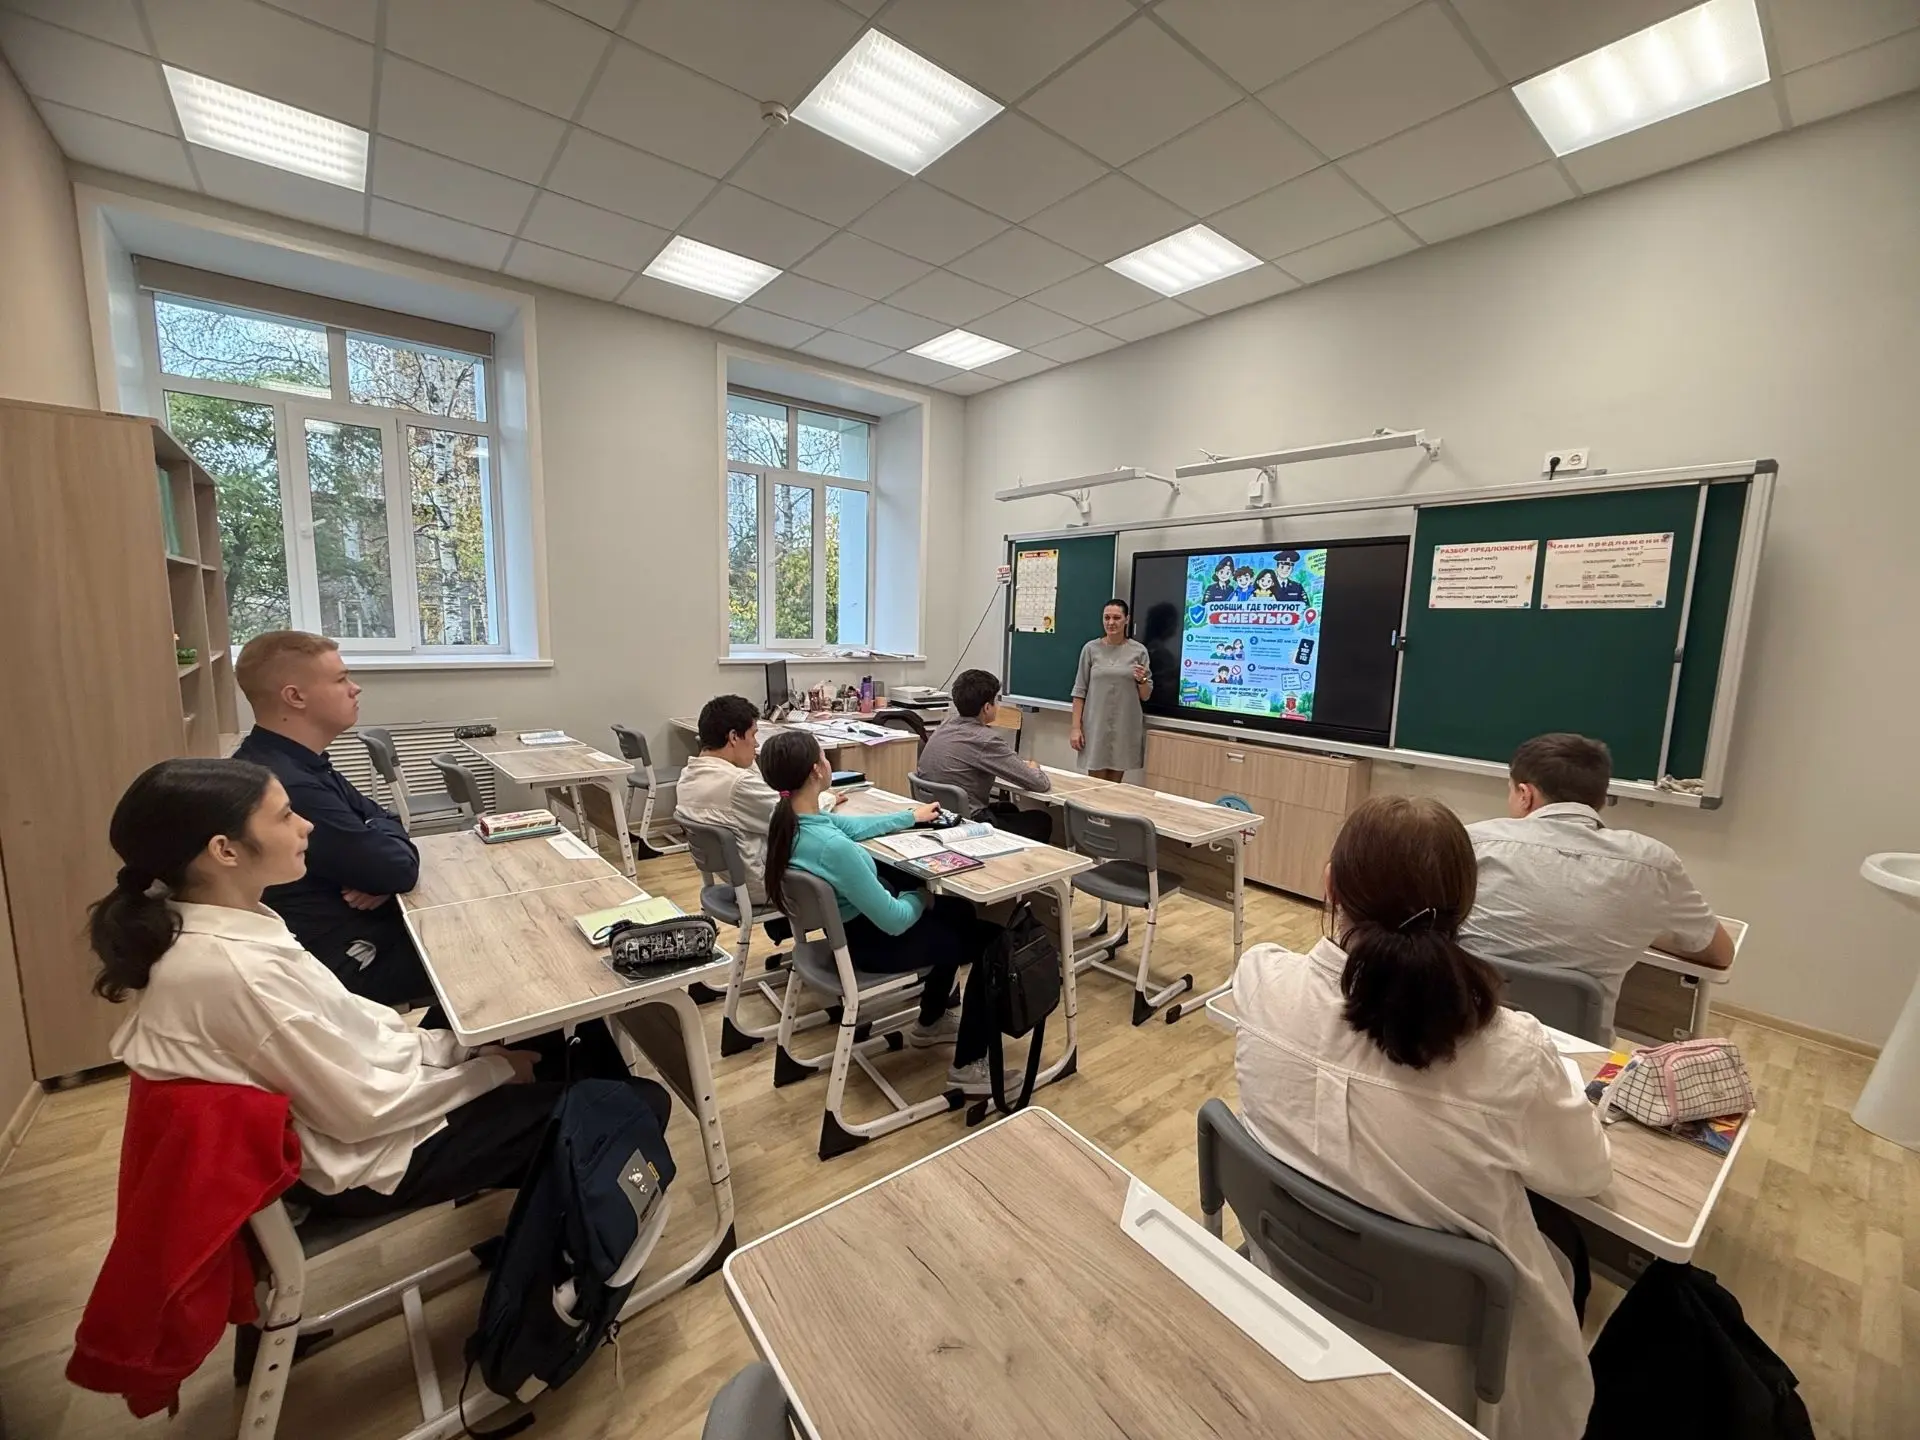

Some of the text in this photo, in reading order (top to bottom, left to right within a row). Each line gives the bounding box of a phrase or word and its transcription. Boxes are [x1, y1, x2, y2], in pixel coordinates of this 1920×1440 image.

[1470, 544, 1533, 553] ПРЕДЛОЖЕНИЯ
[1247, 603, 1261, 611] ГДЕ
[1263, 603, 1300, 611] ТОРГУЮТ
[1218, 612, 1293, 624] СМЕРТЬЮ
